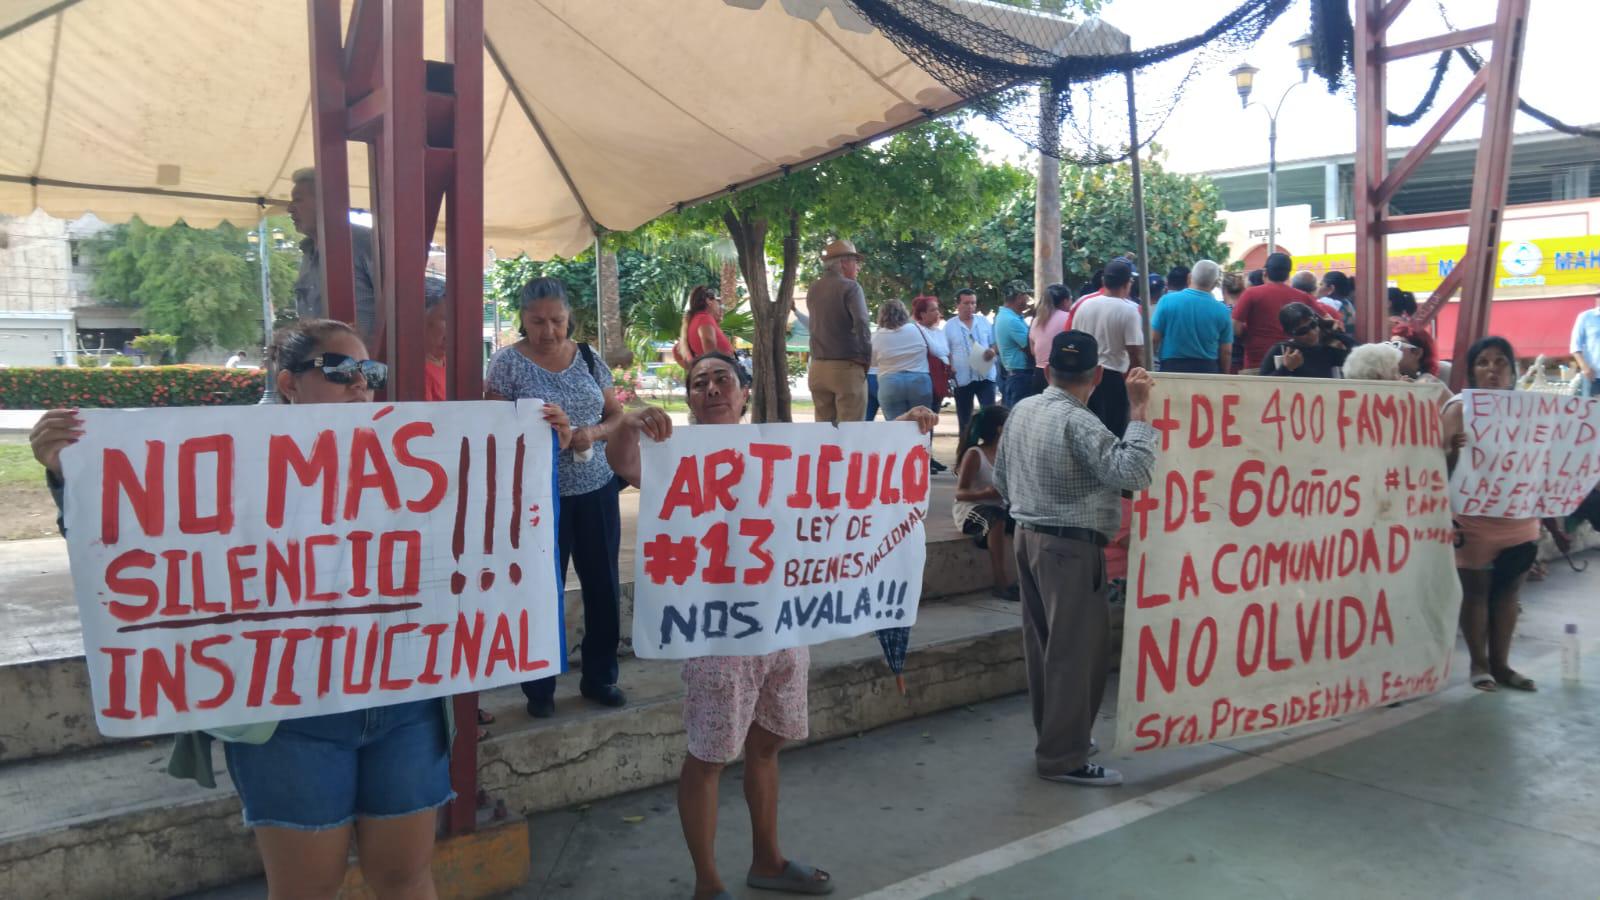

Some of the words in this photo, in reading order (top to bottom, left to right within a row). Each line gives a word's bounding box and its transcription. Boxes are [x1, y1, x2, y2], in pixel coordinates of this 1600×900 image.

[1261, 388, 1325, 453] 400
[101, 433, 236, 545] NO
[658, 442, 930, 520] ARTICULO
[1459, 476, 1505, 496] LAS
[1472, 447, 1551, 474] DIGNA
[796, 513, 839, 543] LEY
[846, 515, 872, 541] DE
[1463, 498, 1499, 513] DE
[105, 529, 421, 621] SILENCIO
[643, 517, 775, 586] #13
[783, 552, 864, 587] BIENES
[864, 507, 927, 577] NACIONAL
[1136, 552, 1200, 609] LA
[1211, 524, 1411, 594] COMUNIDAD
[659, 600, 763, 649] NOS
[1136, 616, 1219, 702] NO
[1236, 588, 1395, 678] OLVIDA
[100, 608, 549, 720] INSTITUCINAL
[1134, 713, 1204, 752] Sra.
